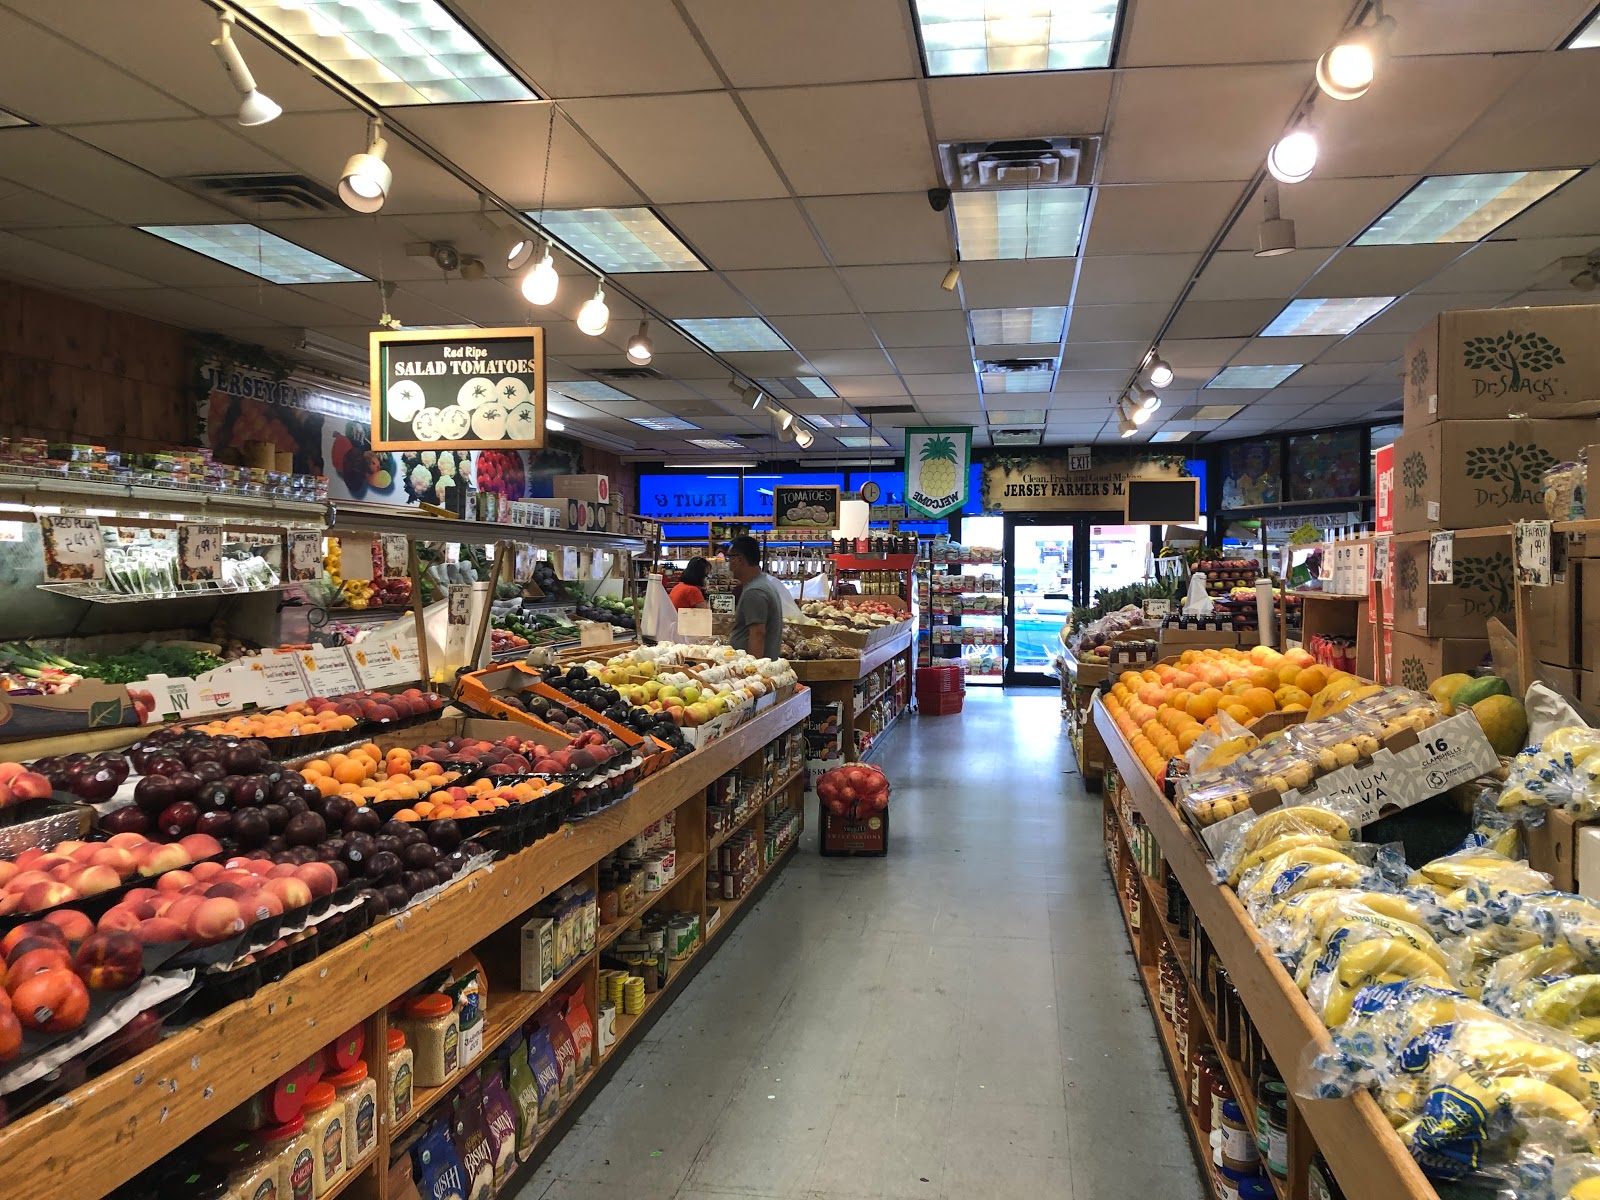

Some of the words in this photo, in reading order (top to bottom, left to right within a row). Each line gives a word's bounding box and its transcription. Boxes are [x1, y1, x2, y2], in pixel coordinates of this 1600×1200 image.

[443, 346, 464, 359] Red
[465, 346, 488, 361] Ripe
[394, 361, 447, 376] SALAD
[450, 359, 535, 375] TOMATOES
[207, 368, 277, 404] JERSEY
[1071, 456, 1090, 470] EXIT
[781, 490, 832, 504] TOMATOES
[1004, 484, 1048, 497] JERSEY
[170, 693, 189, 711] NY
[1424, 738, 1448, 756] 16
[1421, 746, 1462, 767] CLAMSHELLS
